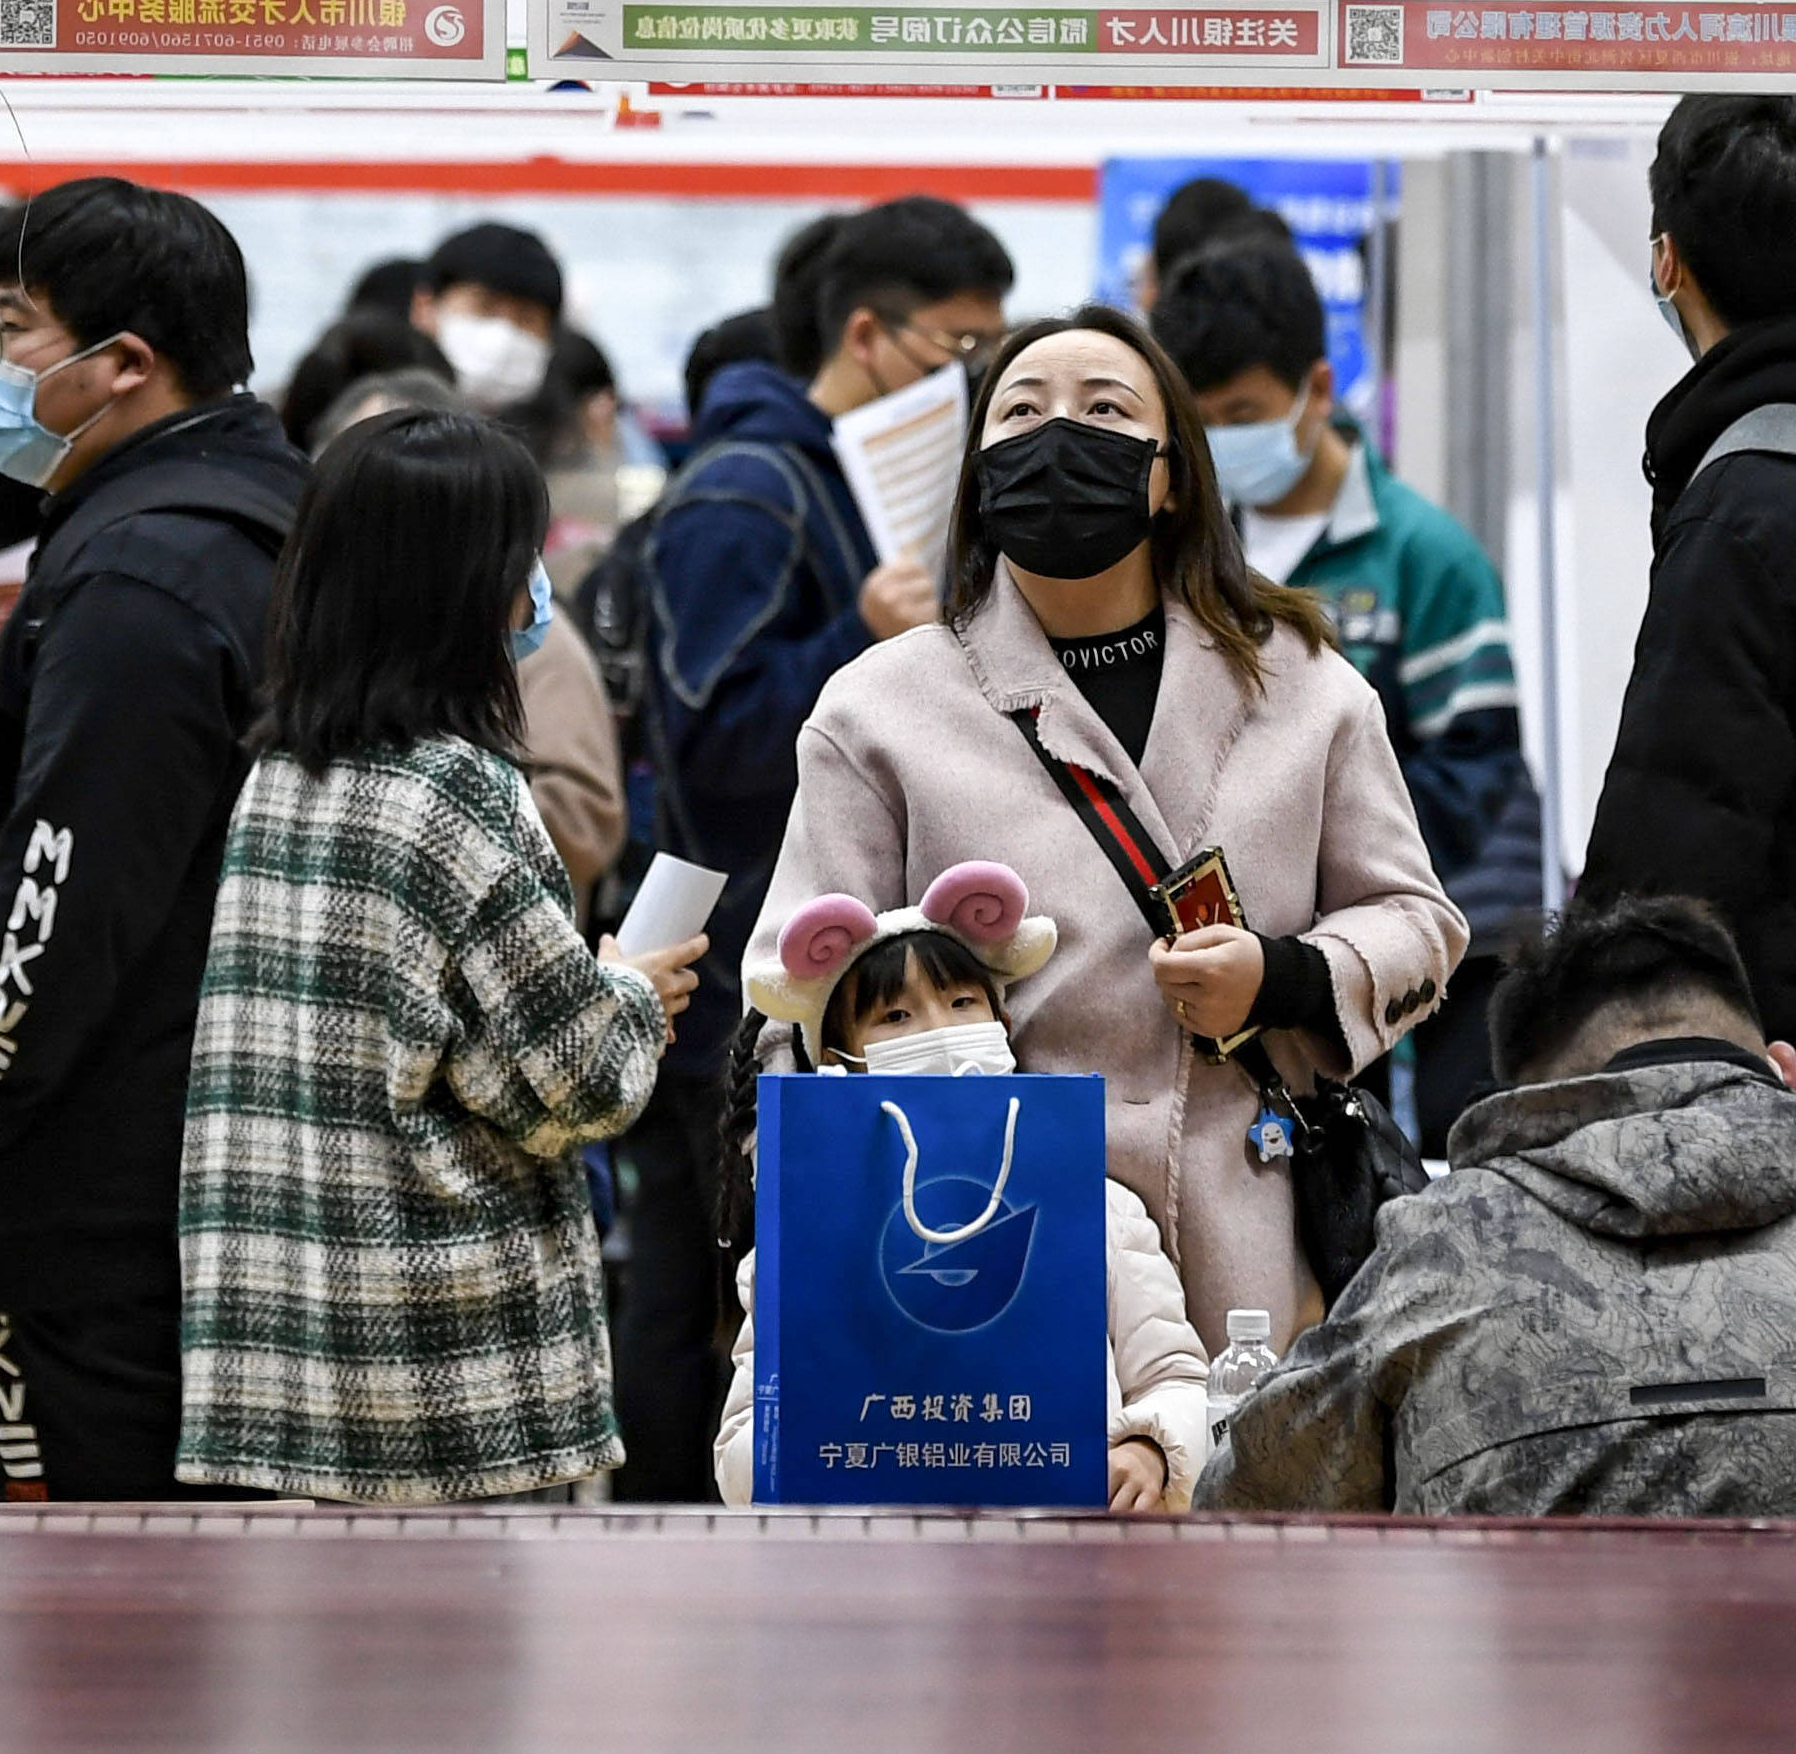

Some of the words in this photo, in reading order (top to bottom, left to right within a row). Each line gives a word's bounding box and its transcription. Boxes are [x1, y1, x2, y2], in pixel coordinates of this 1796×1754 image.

[1055, 630, 1159, 668] OVICTOR
[859, 1393, 1033, 1423] 广西投资集团
[818, 1442, 1071, 1469] 宁夏广银铝业有限公司
